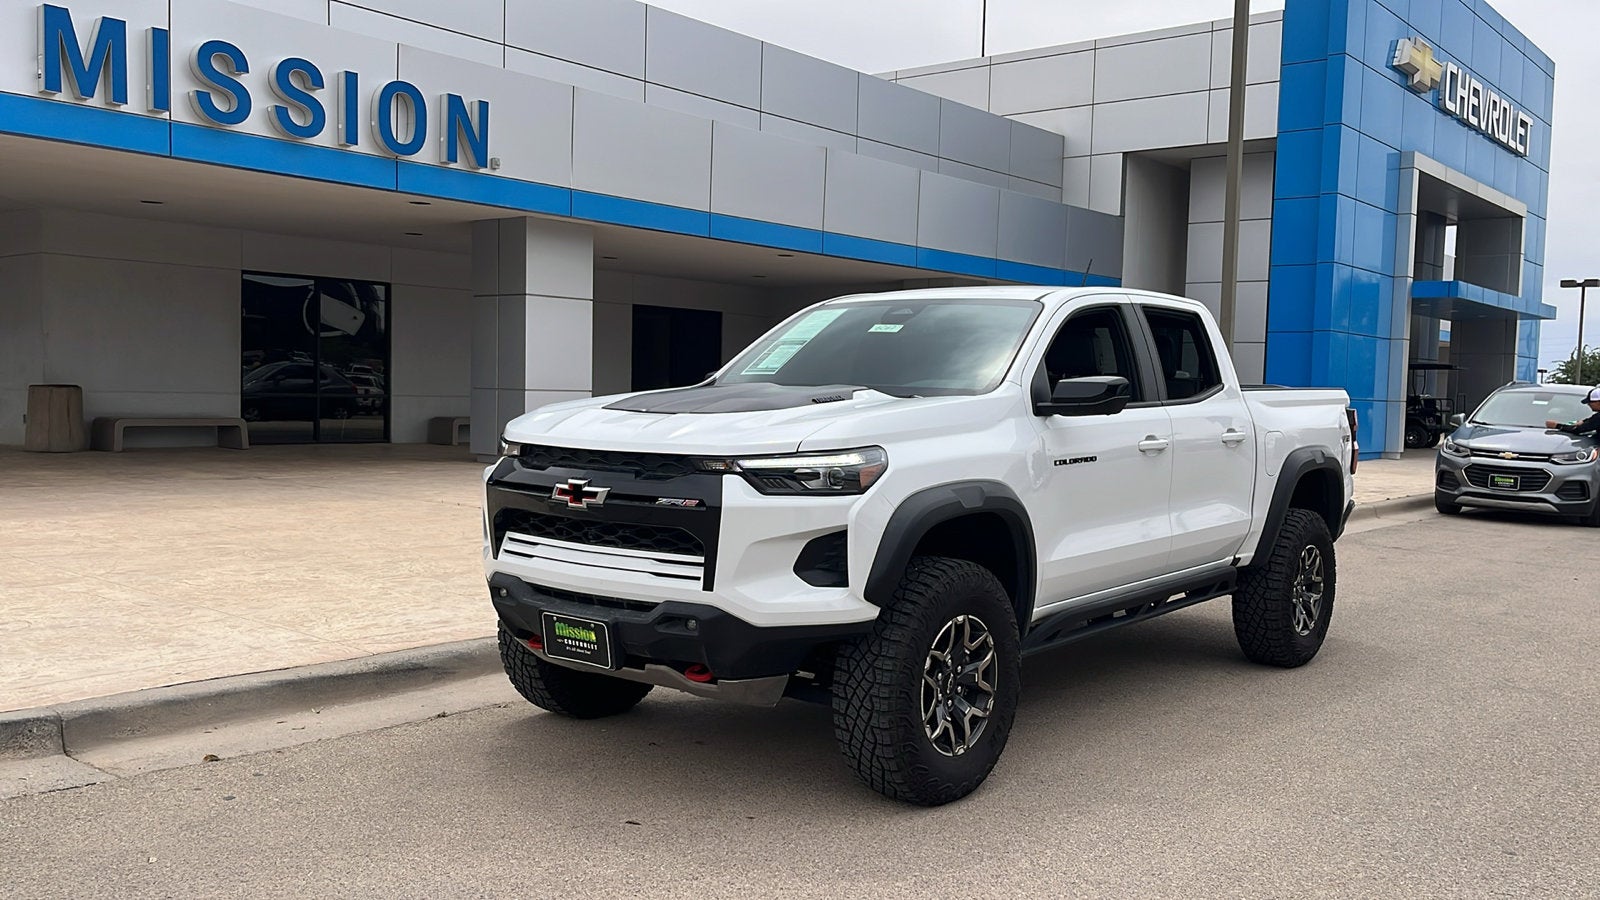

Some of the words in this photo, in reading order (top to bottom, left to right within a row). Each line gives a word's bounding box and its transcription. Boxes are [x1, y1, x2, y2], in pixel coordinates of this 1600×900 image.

[37, 3, 490, 169] MISSION
[1441, 61, 1534, 157] CHEVROLET
[1054, 456, 1097, 466] COLORADO
[554, 621, 597, 643] Mission
